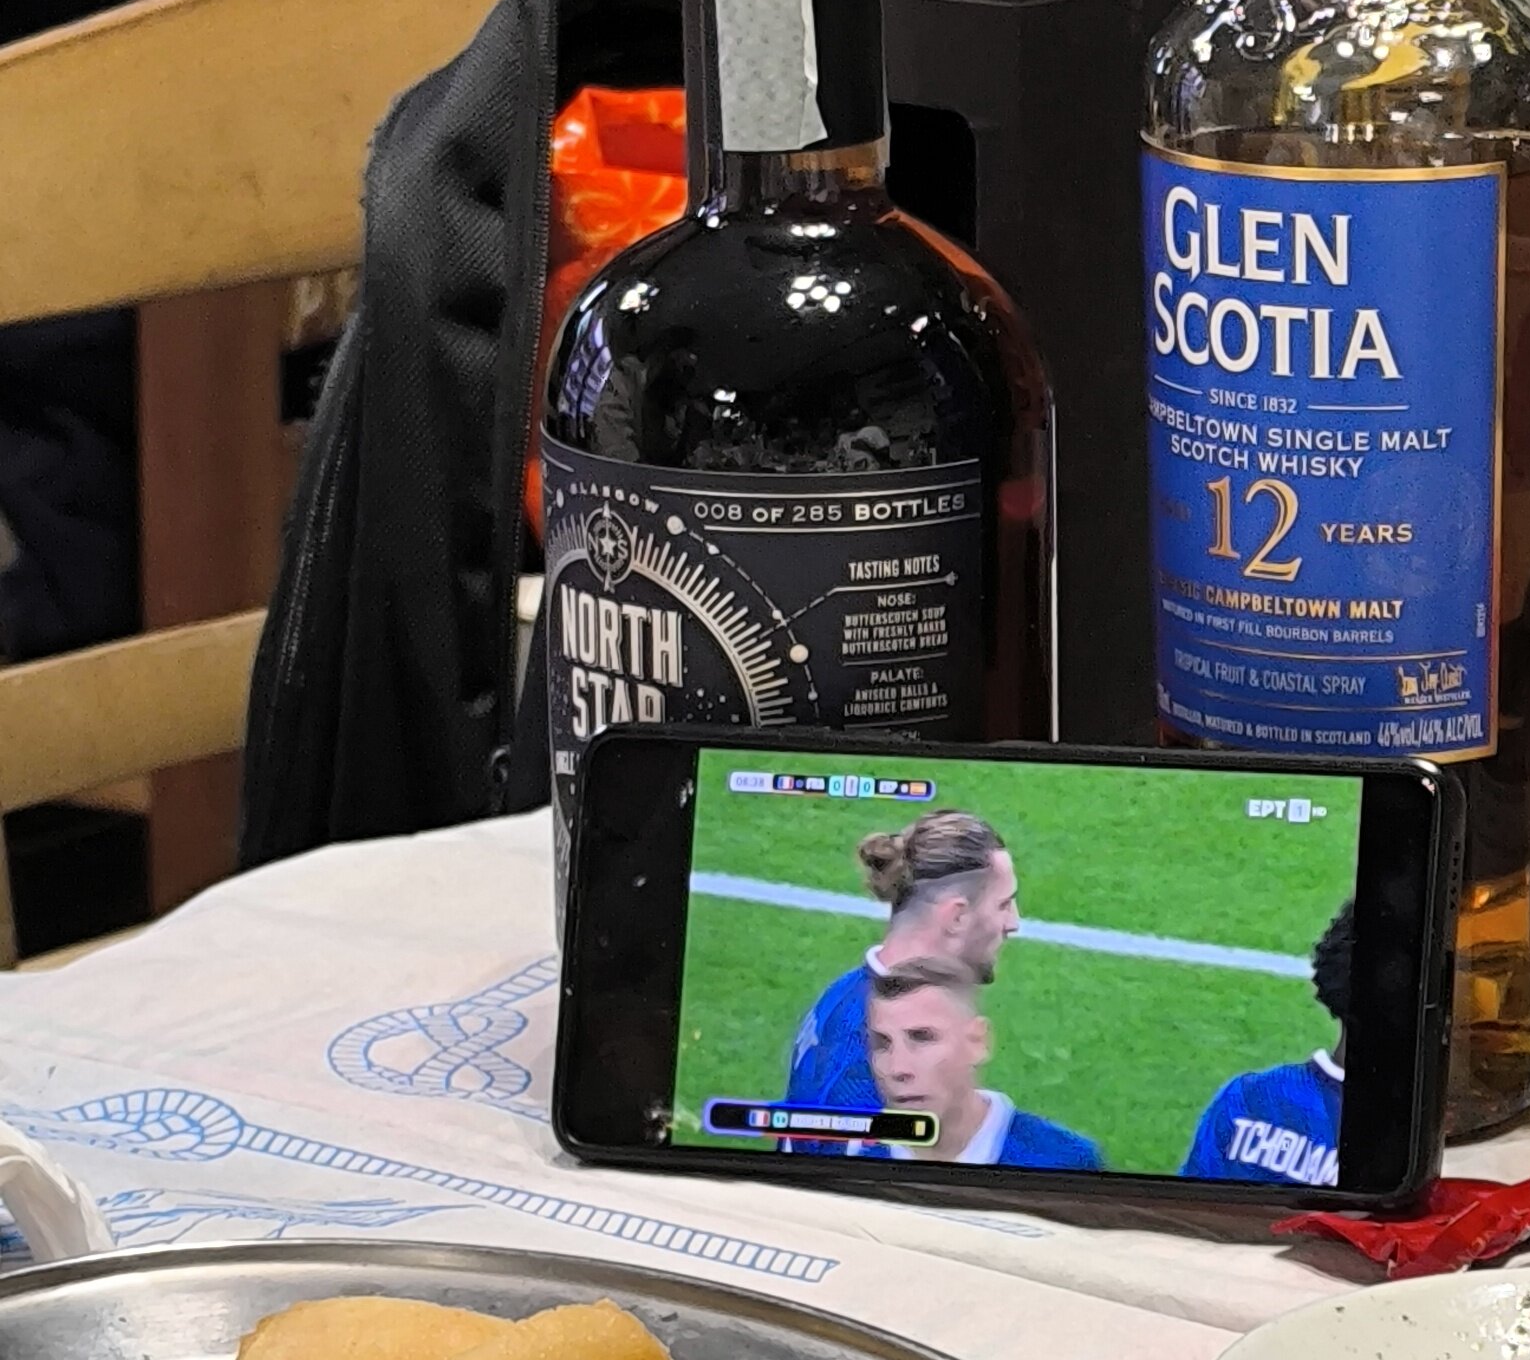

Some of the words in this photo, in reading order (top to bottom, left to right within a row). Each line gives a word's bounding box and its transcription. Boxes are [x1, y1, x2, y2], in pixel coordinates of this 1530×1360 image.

[1164, 185, 1352, 286] GLEN
[1153, 272, 1403, 379] SCOTIA
[1209, 387, 1257, 411] SINCE
[1262, 395, 1298, 415] 1832
[1171, 434, 1249, 470] SCOTCH
[1258, 451, 1364, 478] WHISKY
[1267, 428, 1370, 452] SINGLE
[1380, 427, 1453, 452] MALT
[694, 501, 742, 522] 008
[752, 507, 784, 523] OF
[792, 504, 842, 523] 285
[854, 493, 966, 521] BOTTLES
[1206, 474, 1302, 583] 12
[1320, 522, 1413, 544] YEARS
[849, 559, 899, 581] TASTING
[904, 554, 940, 576] NOTES
[1206, 585, 1340, 619] CAMPBELTOWN
[1350, 600, 1403, 619] MALT
[561, 583, 683, 688] NORTH
[1207, 615, 1235, 632] FIRST
[1266, 625, 1328, 643] BOURBON
[1333, 629, 1394, 644] BARRELS
[1216, 662, 1245, 686] FRUIT
[1263, 669, 1317, 693] COASTAL
[1323, 676, 1365, 695] SPRAY
[1256, 724, 1298, 742] BOTTLED
[1315, 730, 1371, 745] SCOTLAND
